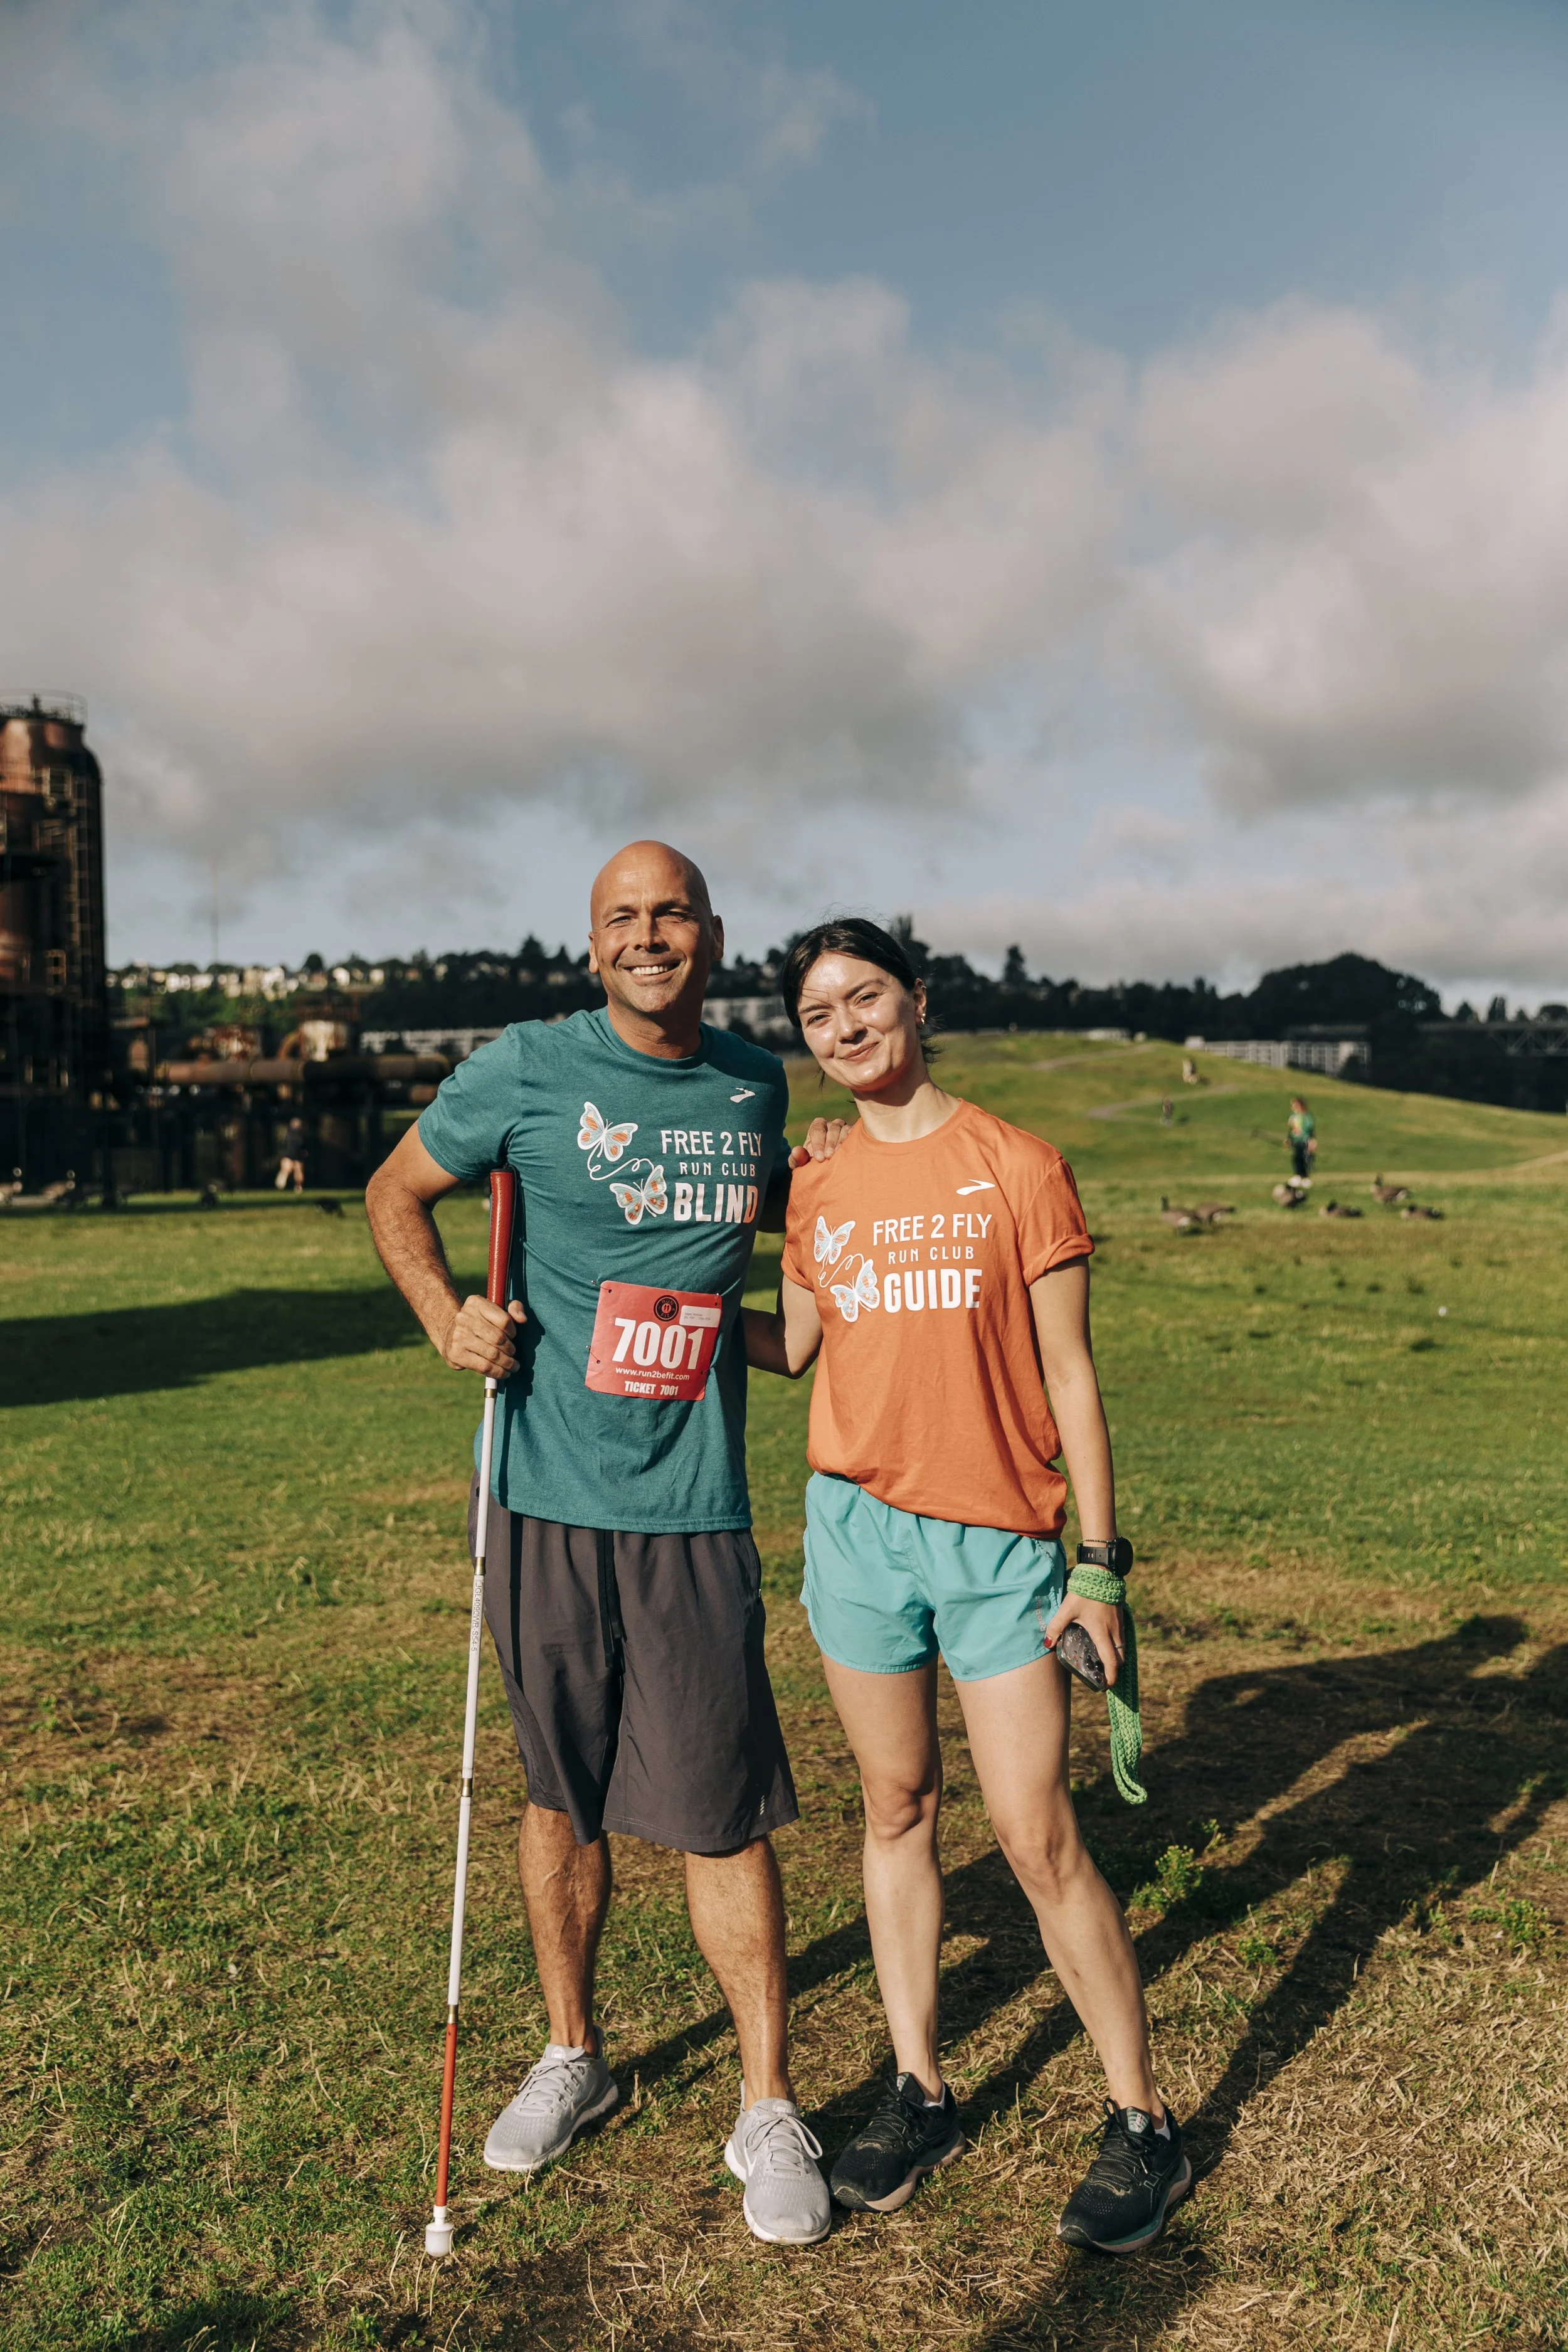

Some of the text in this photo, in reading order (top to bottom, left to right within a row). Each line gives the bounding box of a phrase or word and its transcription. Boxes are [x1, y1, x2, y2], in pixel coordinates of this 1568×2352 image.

[660, 1130, 761, 1157] FREE 2 FLY
[679, 1162, 755, 1177] RUN CLUB
[673, 1182, 758, 1223] BLIND
[873, 1214, 992, 1246] FREE 2 FLY
[888, 1246, 974, 1264] RUN CLUB
[884, 1268, 982, 1313] GUIDE
[612, 1317, 704, 1370] 7001
[615, 1367, 690, 1380] www.run2befit.com
[624, 1380, 679, 1396] TICKET 7001
